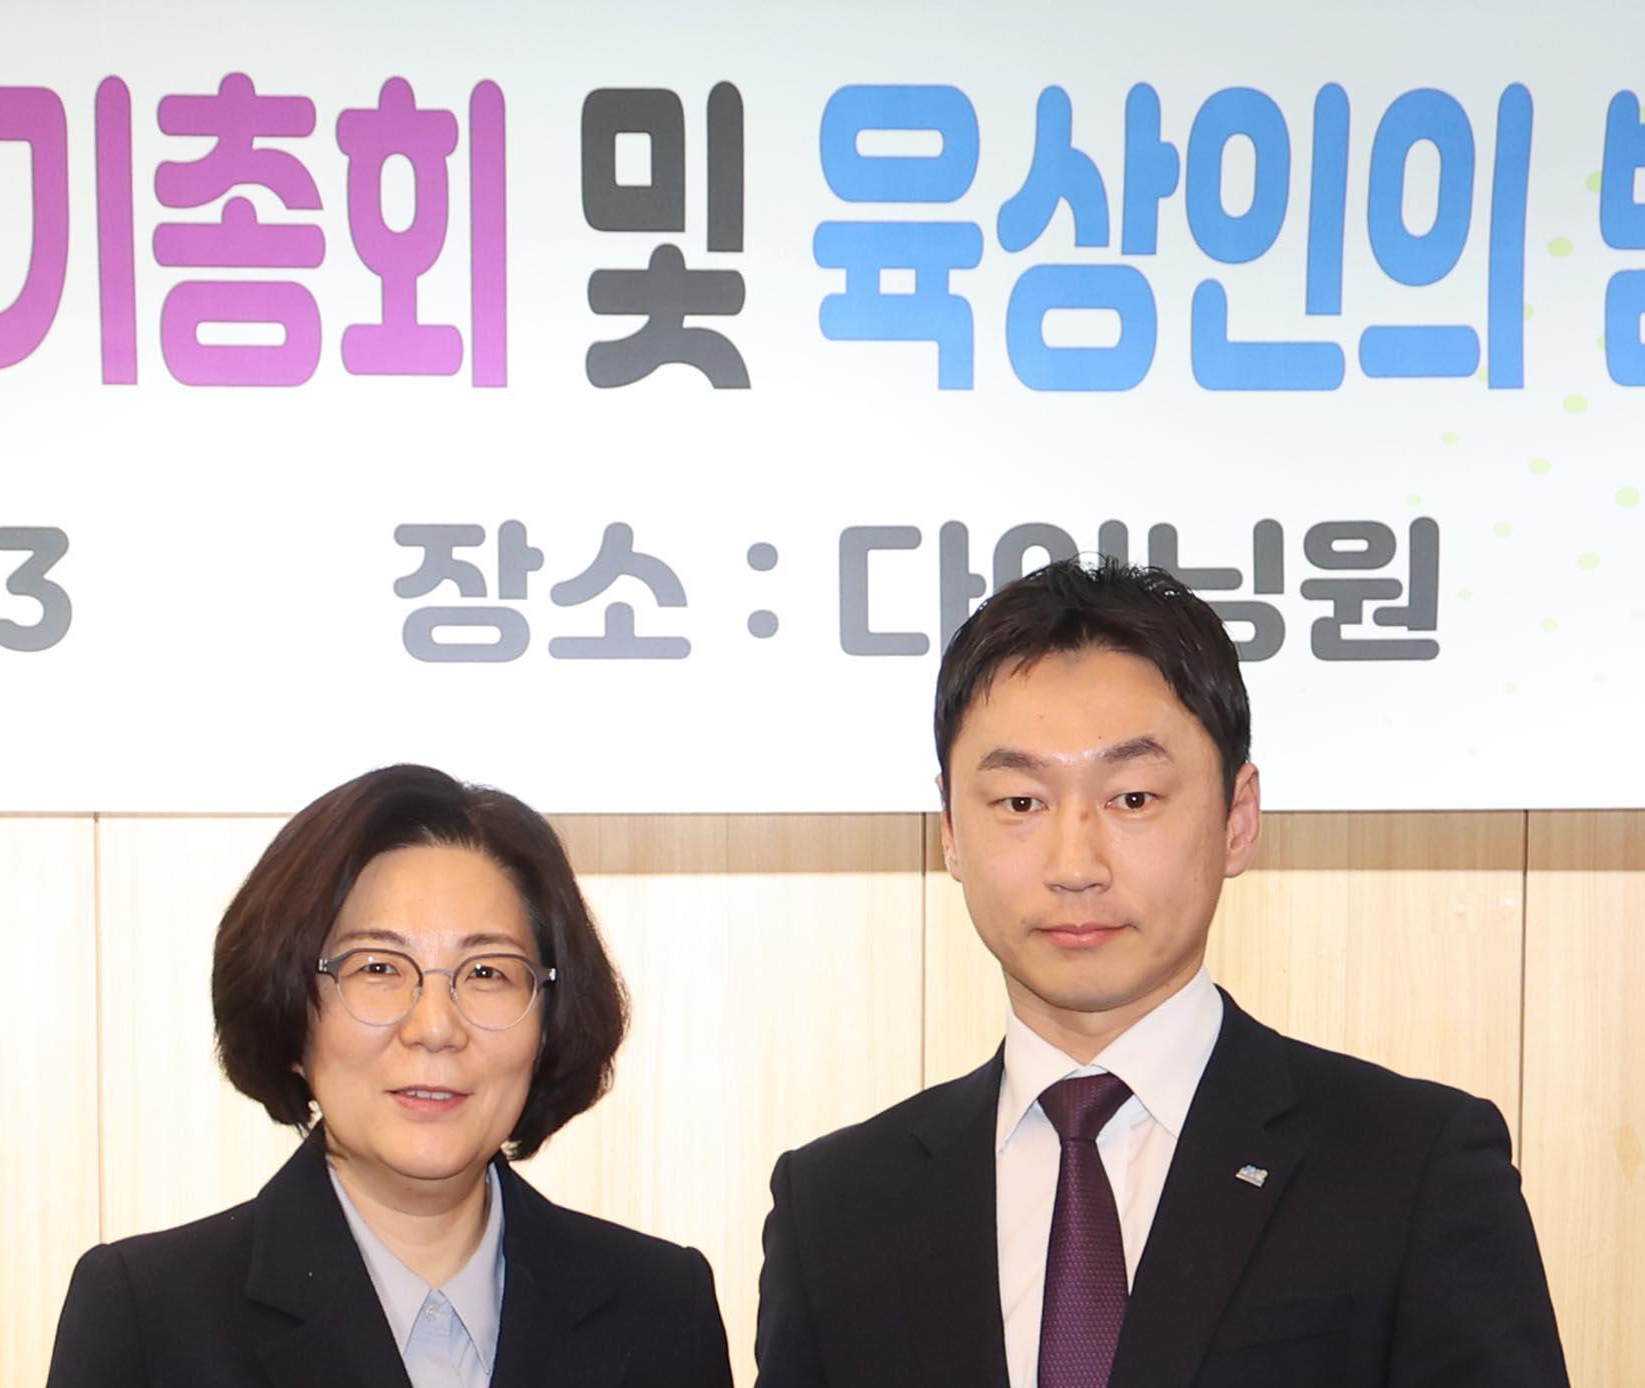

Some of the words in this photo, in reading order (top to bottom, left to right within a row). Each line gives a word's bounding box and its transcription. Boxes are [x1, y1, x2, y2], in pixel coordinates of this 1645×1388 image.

[581, 80, 751, 390] 및
[813, 82, 1533, 391] 육상인의
[393, 519, 692, 663] 장소
